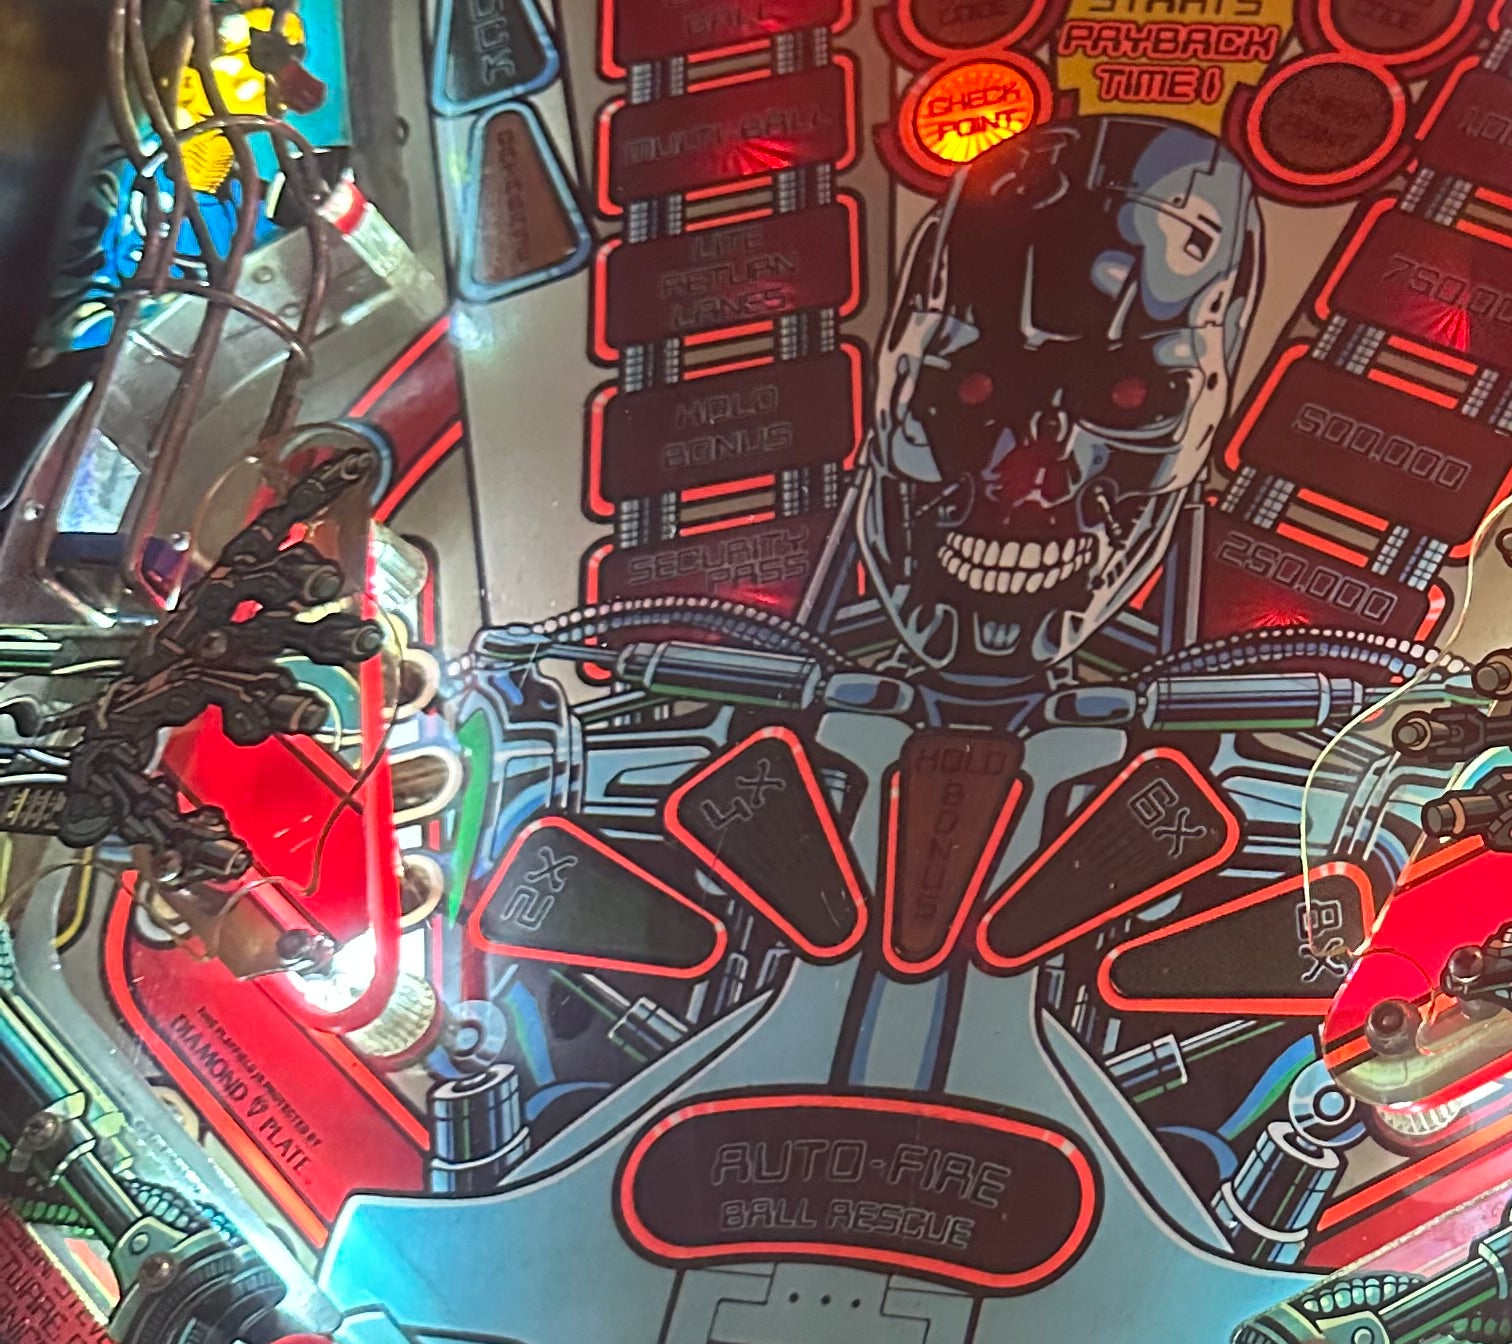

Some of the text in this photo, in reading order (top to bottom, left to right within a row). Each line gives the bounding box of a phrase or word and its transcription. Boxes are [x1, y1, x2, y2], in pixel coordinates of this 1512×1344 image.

[1060, 23, 1280, 60] PAYBACK
[926, 83, 1022, 117] CHECK
[935, 109, 1015, 141] POINT
[673, 384, 780, 431] HOLD
[659, 420, 795, 471] BONUS
[706, 554, 812, 592] PASS
[916, 747, 1009, 776] HOLD
[1128, 777, 1208, 860] 6X
[500, 845, 579, 932] 2X
[170, 1012, 311, 1172] DIAMOND PLATE
[711, 1140, 1011, 1208] AUTO-FIRE
[721, 1197, 976, 1250] BALL RESCUE
